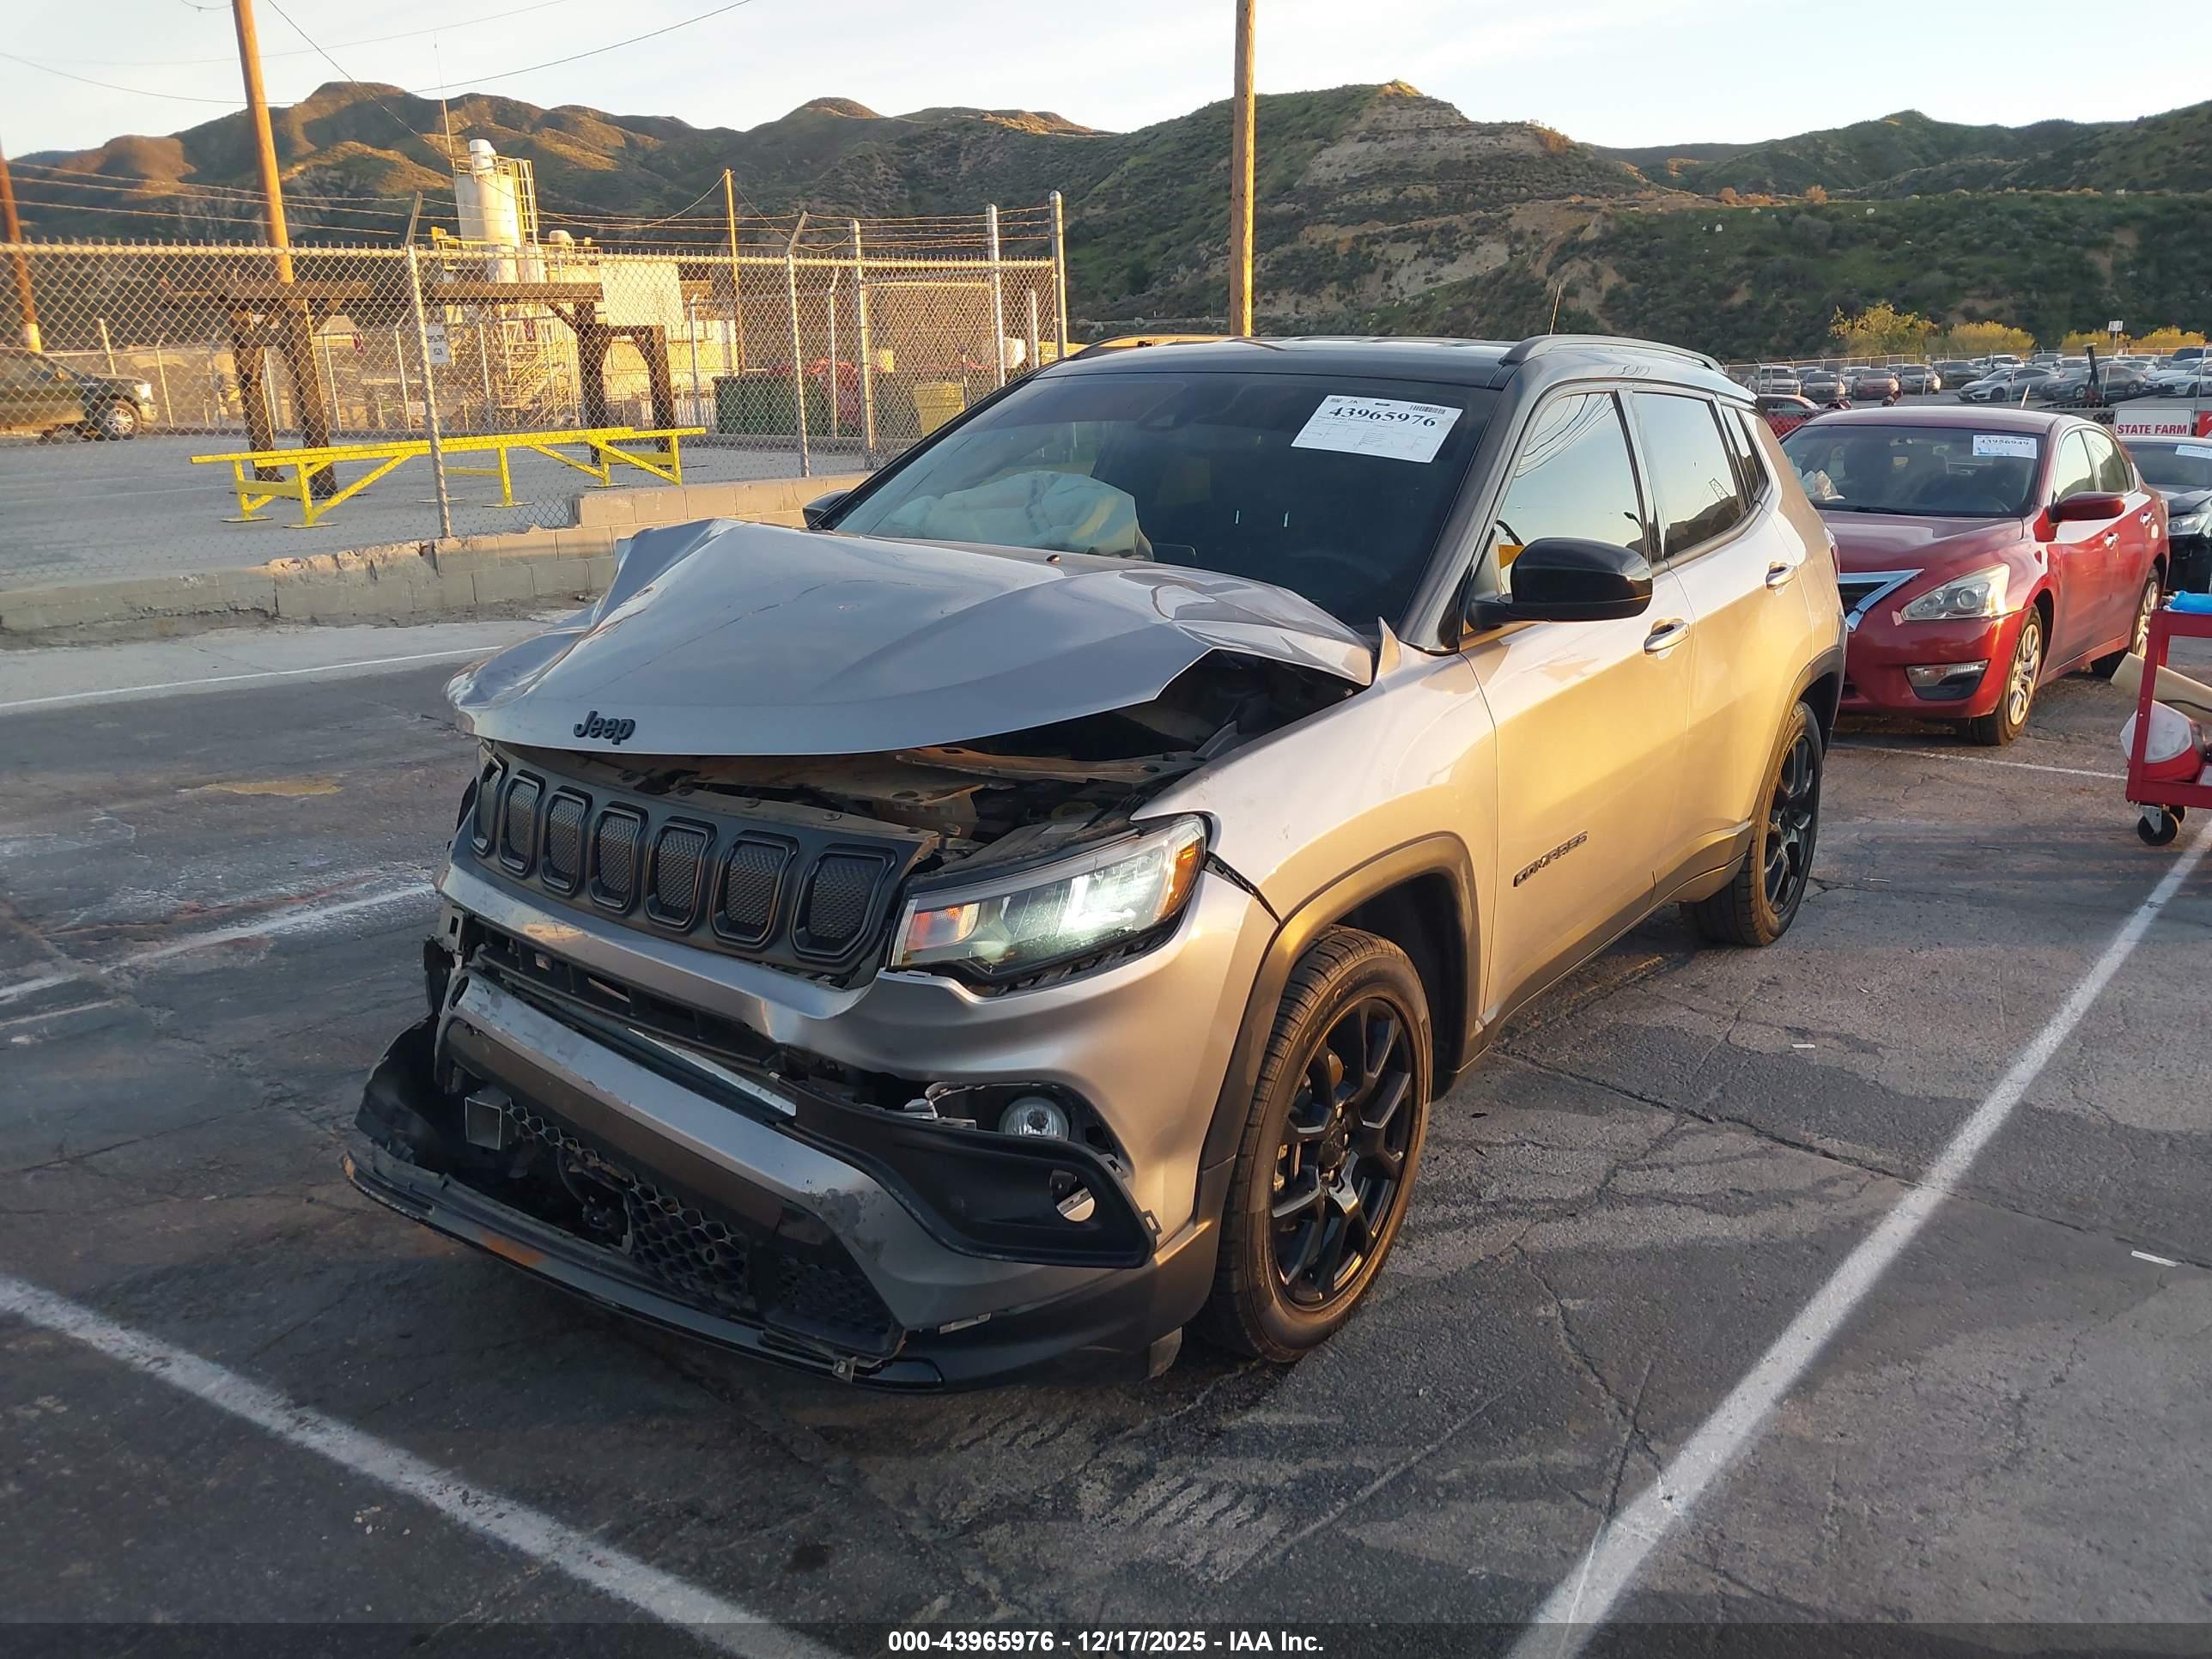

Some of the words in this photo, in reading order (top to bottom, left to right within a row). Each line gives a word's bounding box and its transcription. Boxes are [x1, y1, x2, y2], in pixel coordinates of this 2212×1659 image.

[1329, 406, 1437, 428] 43965976
[2117, 424, 2152, 434] STATE
[2154, 424, 2188, 434] FARM
[574, 710, 636, 745] Jeep
[1512, 830, 1589, 888] COMPASS
